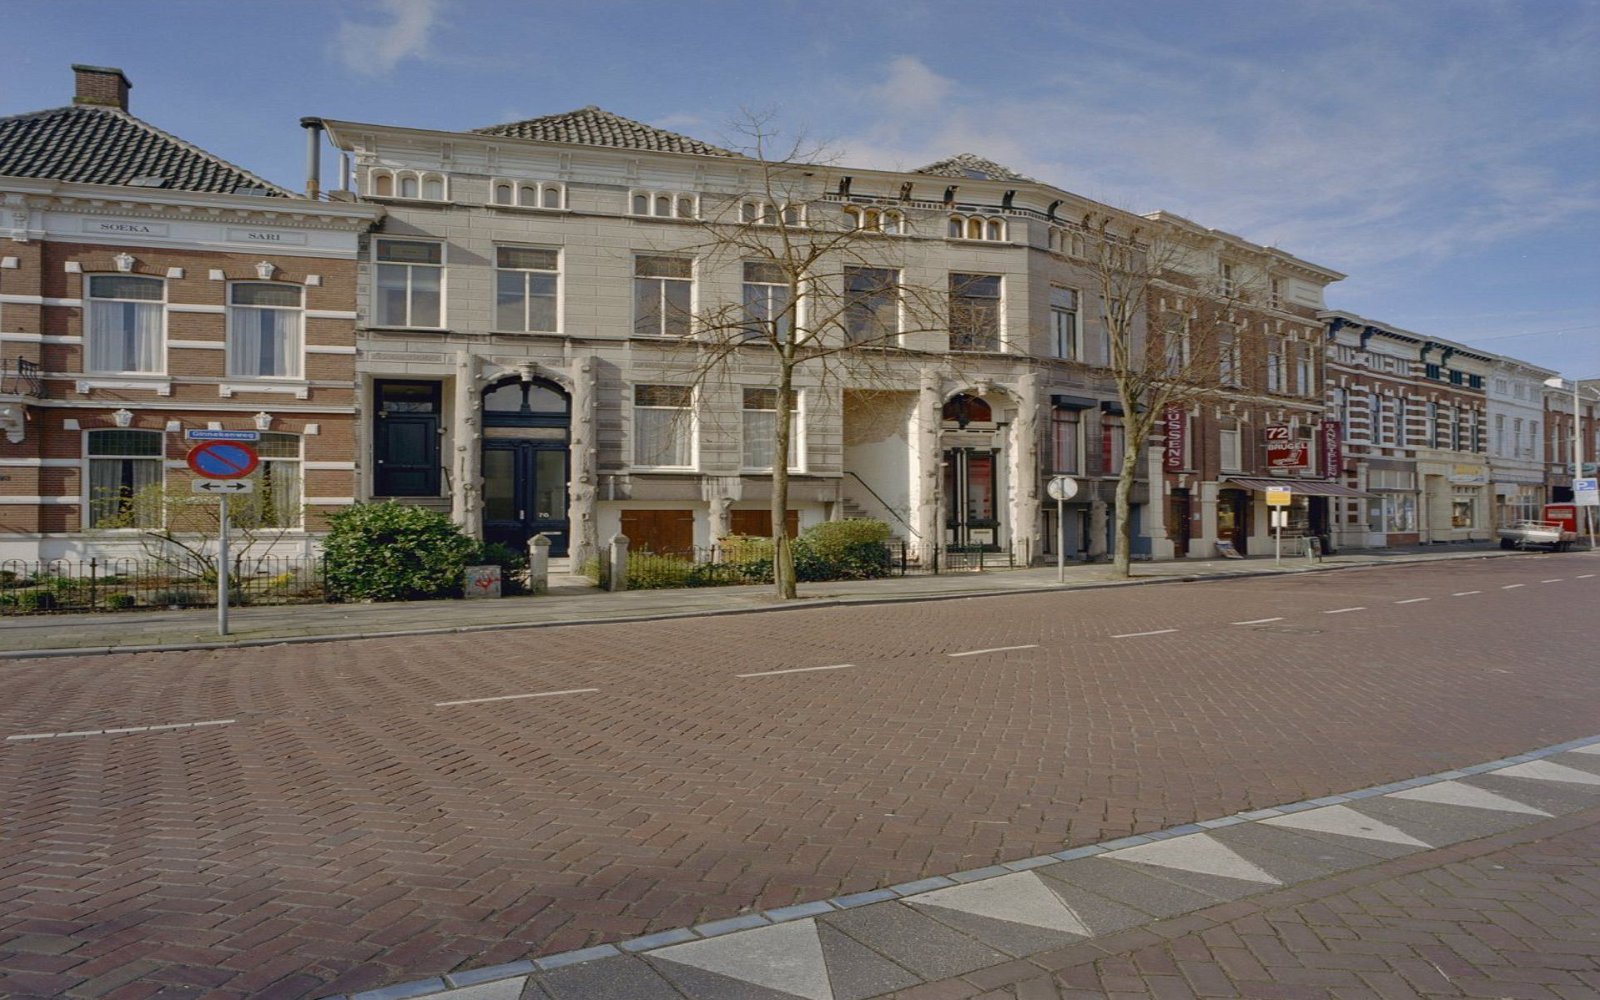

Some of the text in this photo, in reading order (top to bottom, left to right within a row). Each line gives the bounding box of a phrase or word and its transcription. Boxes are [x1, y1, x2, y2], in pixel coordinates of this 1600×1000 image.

[100, 223, 150, 232] SOEKA
[248, 232, 281, 241] SARI
[1266, 427, 1288, 439] 72
[1576, 481, 1588, 491] P
